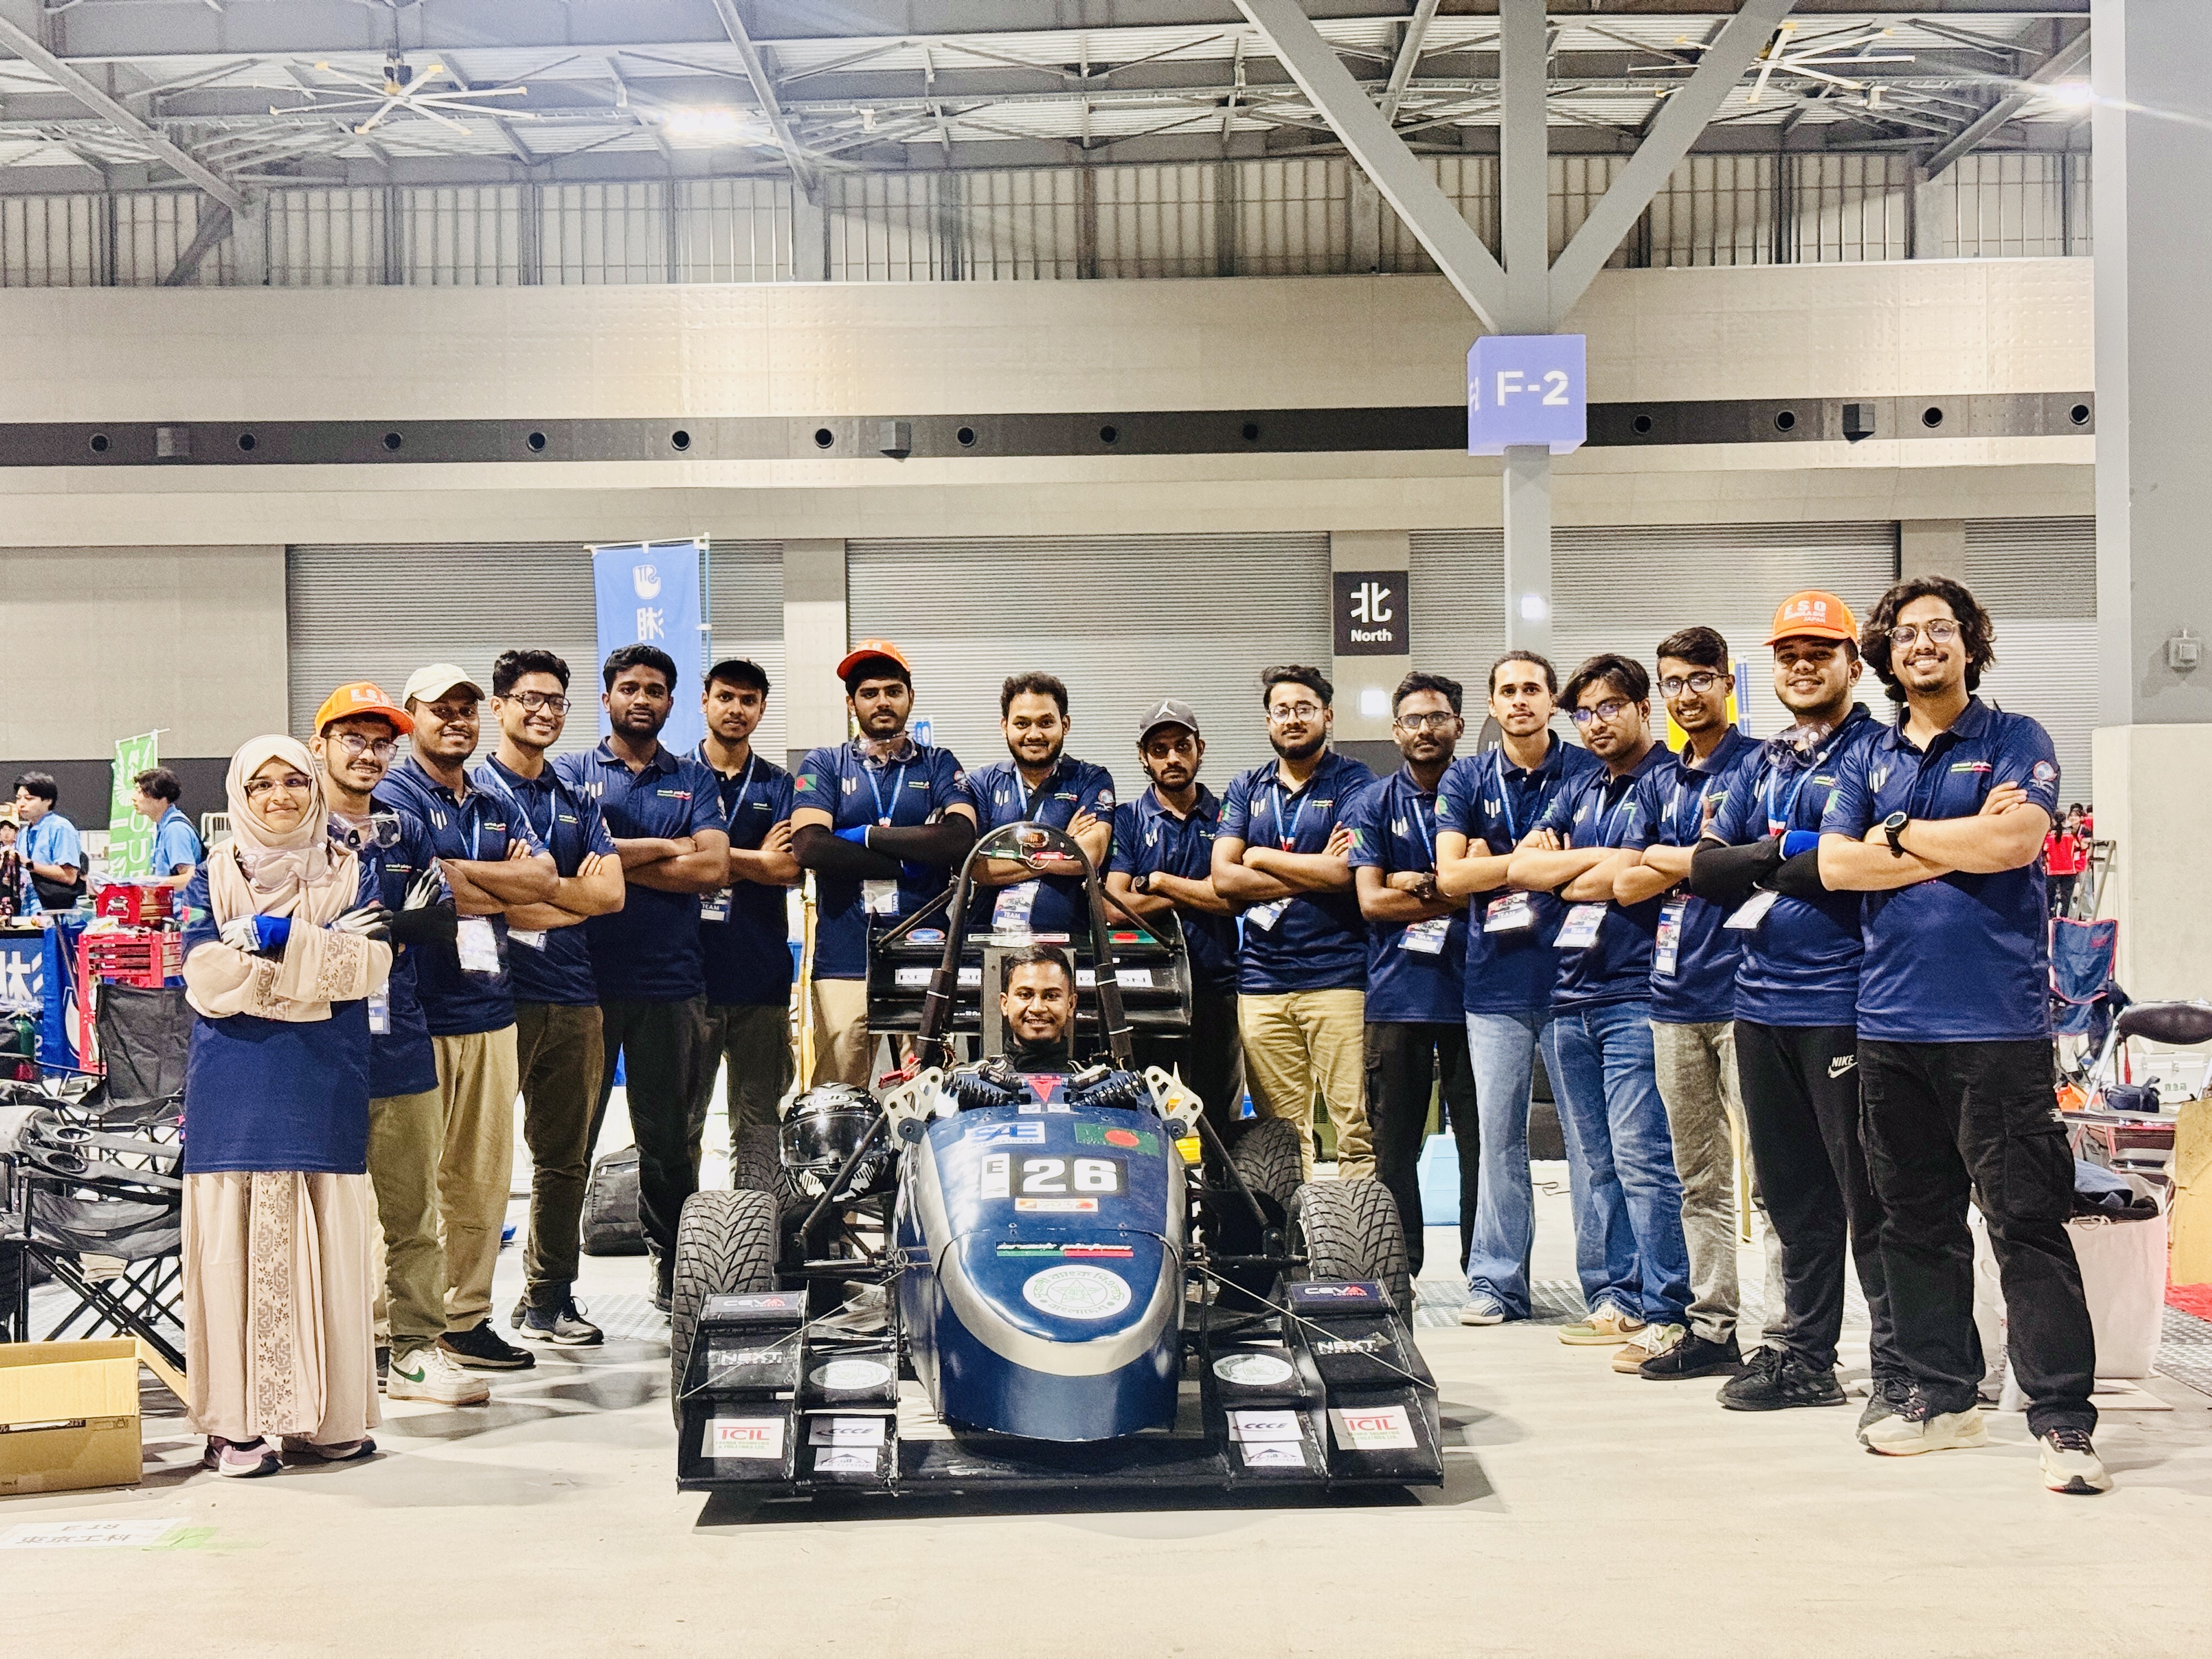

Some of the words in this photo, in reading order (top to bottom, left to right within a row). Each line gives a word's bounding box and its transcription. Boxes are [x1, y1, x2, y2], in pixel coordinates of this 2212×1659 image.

[1497, 370, 1569, 406] F-2
[1350, 582, 1392, 623] 北
[1350, 628, 1392, 642] North
[1831, 1054, 1854, 1068] NIKE
[970, 1124, 1039, 1143] SAE
[988, 1160, 1004, 1175] E
[1023, 1159, 1118, 1192] 26
[1317, 1340, 1377, 1352] NEXT
[721, 1351, 783, 1364] NEXT
[1349, 1419, 1398, 1431] ICIL
[721, 1429, 770, 1441] ICIL
[15, 1534, 132, 1544] 東京工科
